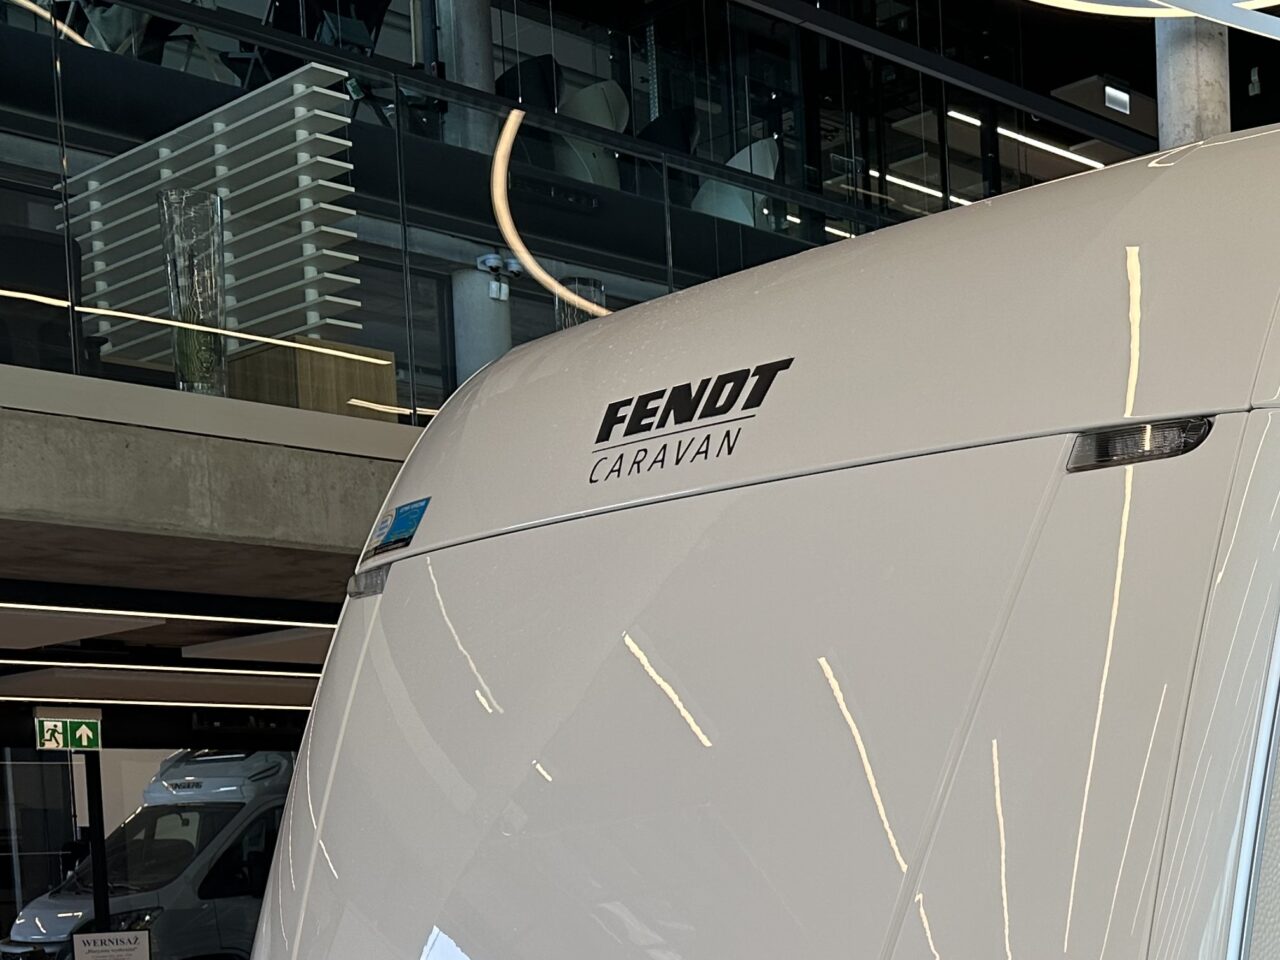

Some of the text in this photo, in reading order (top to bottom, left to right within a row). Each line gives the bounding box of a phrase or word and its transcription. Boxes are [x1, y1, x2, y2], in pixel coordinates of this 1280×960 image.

[594, 357, 796, 445] FENDT
[588, 427, 742, 484] CARAVAN
[82, 935, 140, 947] WERNISAŻ
